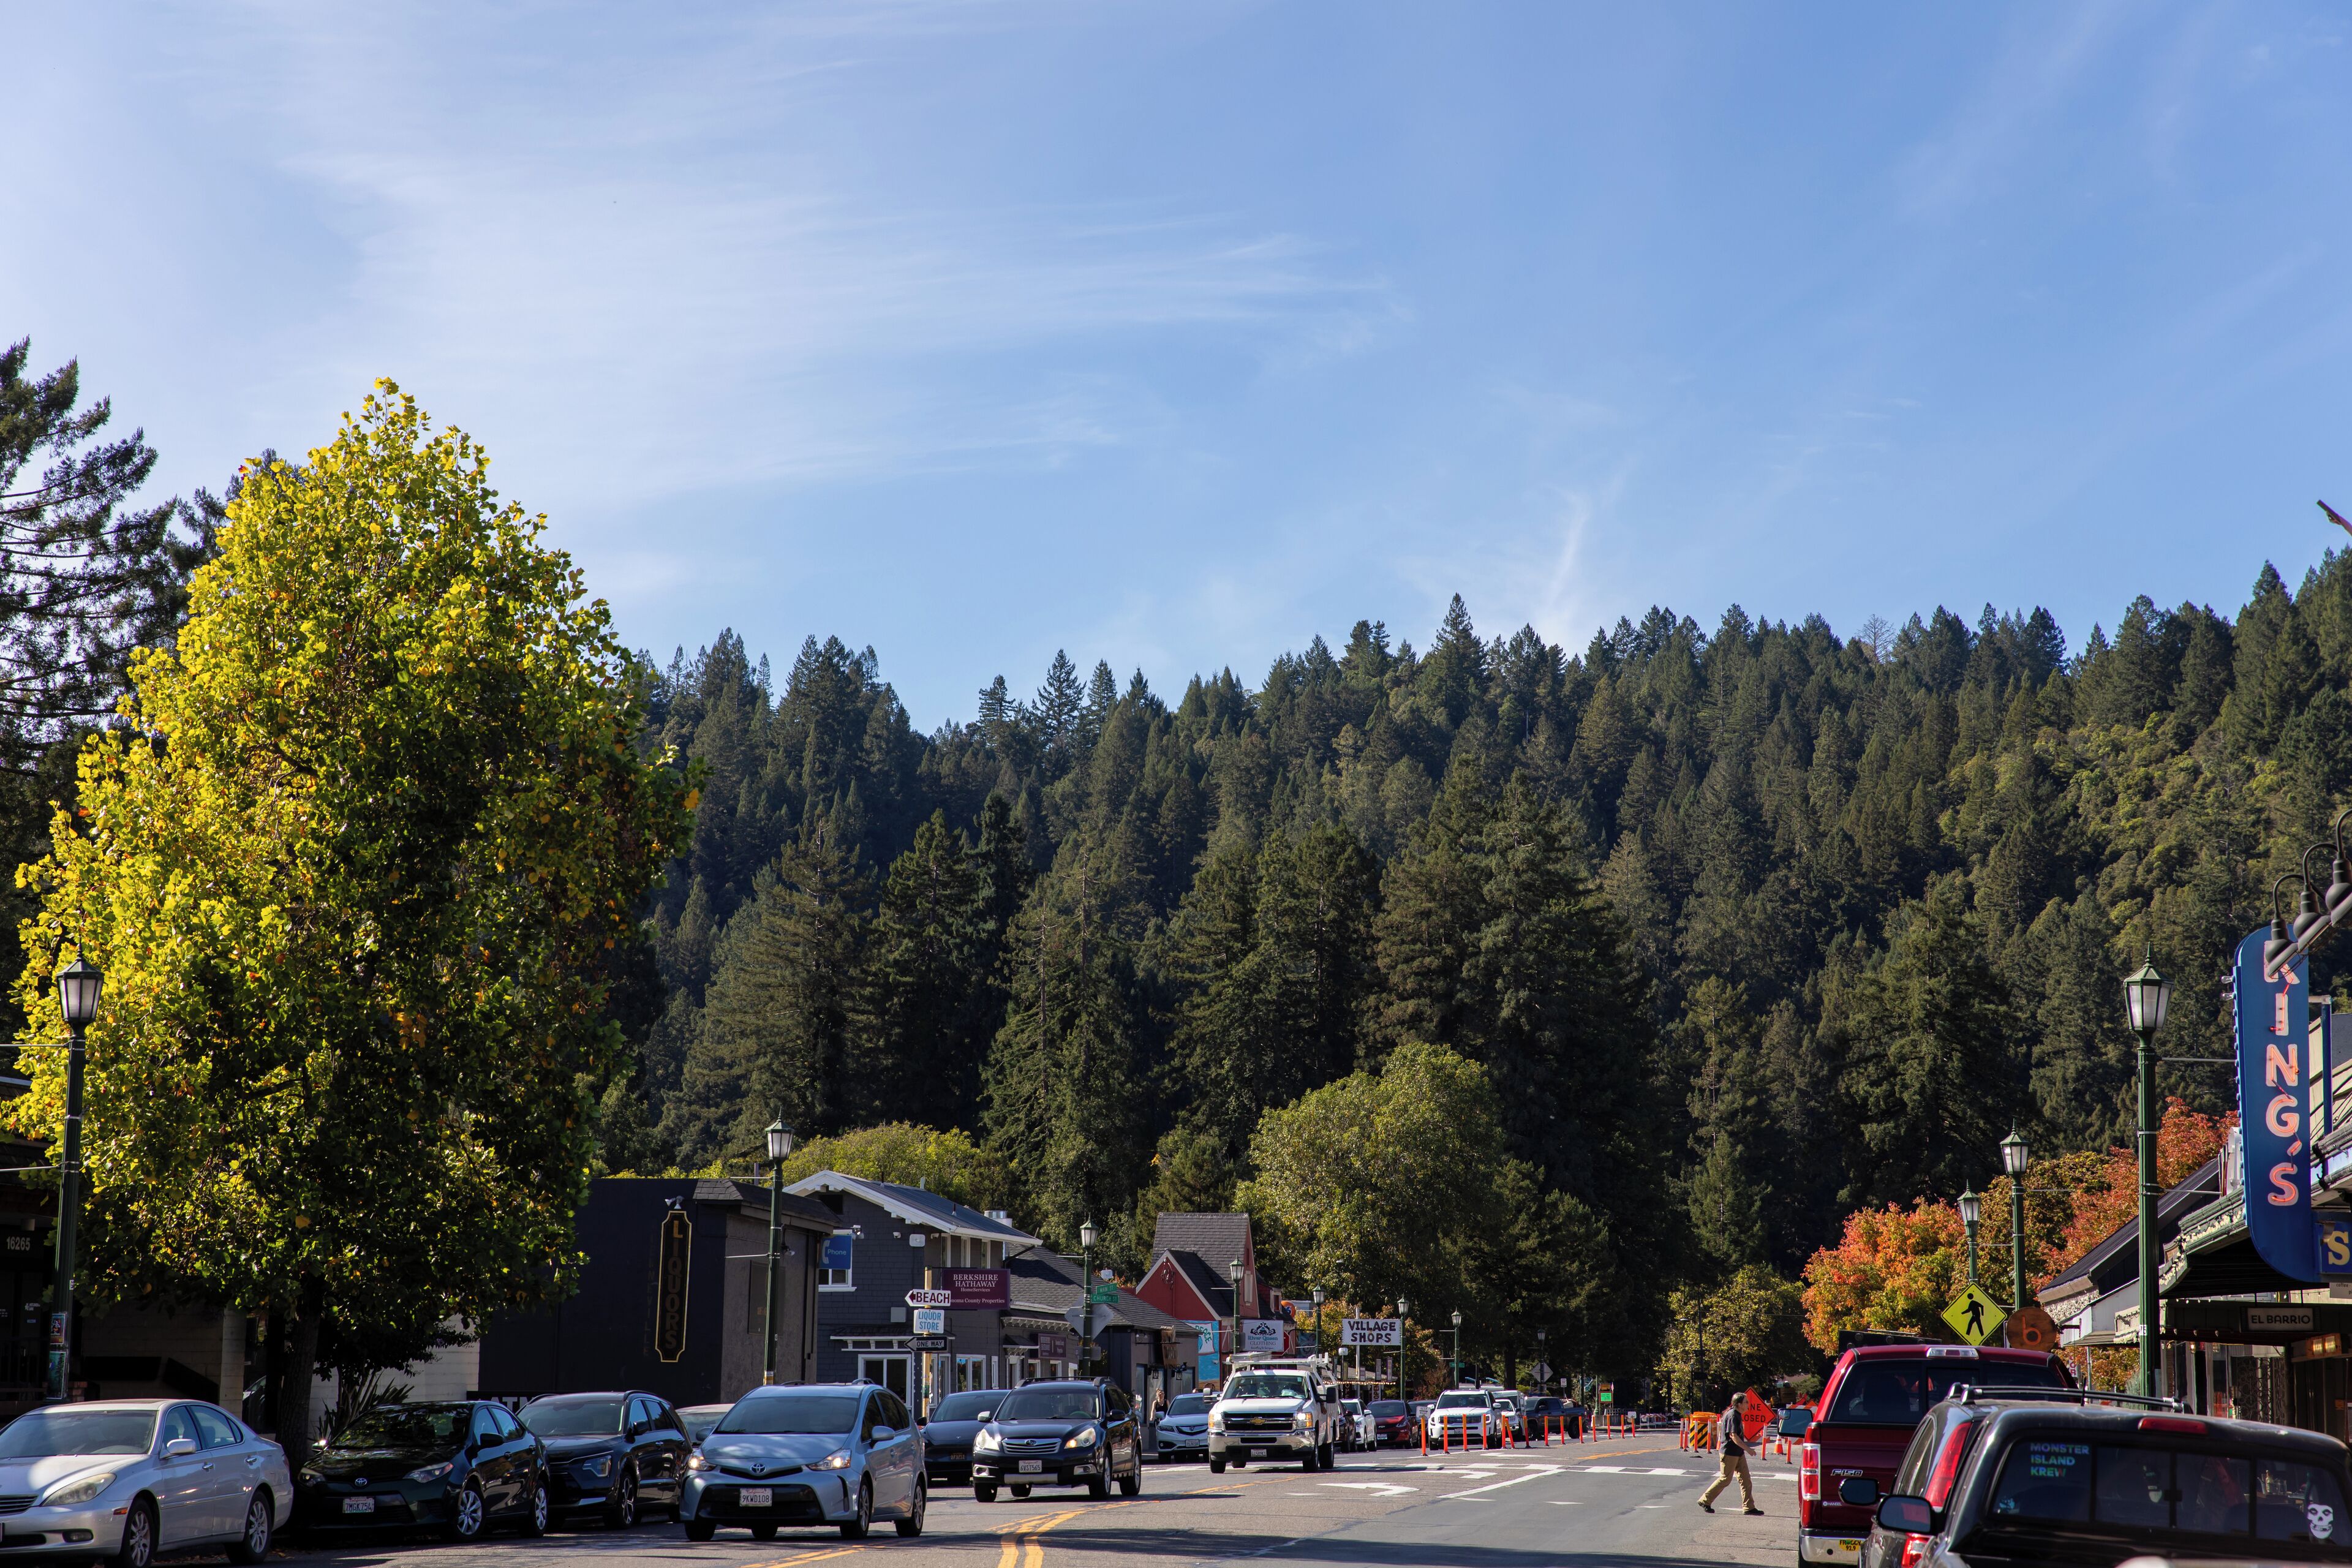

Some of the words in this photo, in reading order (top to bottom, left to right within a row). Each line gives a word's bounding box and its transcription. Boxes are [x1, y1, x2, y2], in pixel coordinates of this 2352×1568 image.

[7, 1236, 31, 1251] 16265
[665, 1219, 684, 1349] LIQUORS
[916, 1292, 950, 1304] BEACH
[918, 1311, 941, 1321] LIQUOR
[2251, 1315, 2264, 1324] EL
[2267, 1315, 2310, 1324] BARRIO
[919, 1321, 939, 1330] STORE
[1348, 1321, 1396, 1331] VILLAGE
[1351, 1333, 1391, 1343] SHOPS
[1743, 1414, 1766, 1423] OSED
[2030, 1442, 2089, 1454] MONSTER
[2030, 1454, 2076, 1466] ISLAND
[2030, 1466, 2067, 1477] KREW
